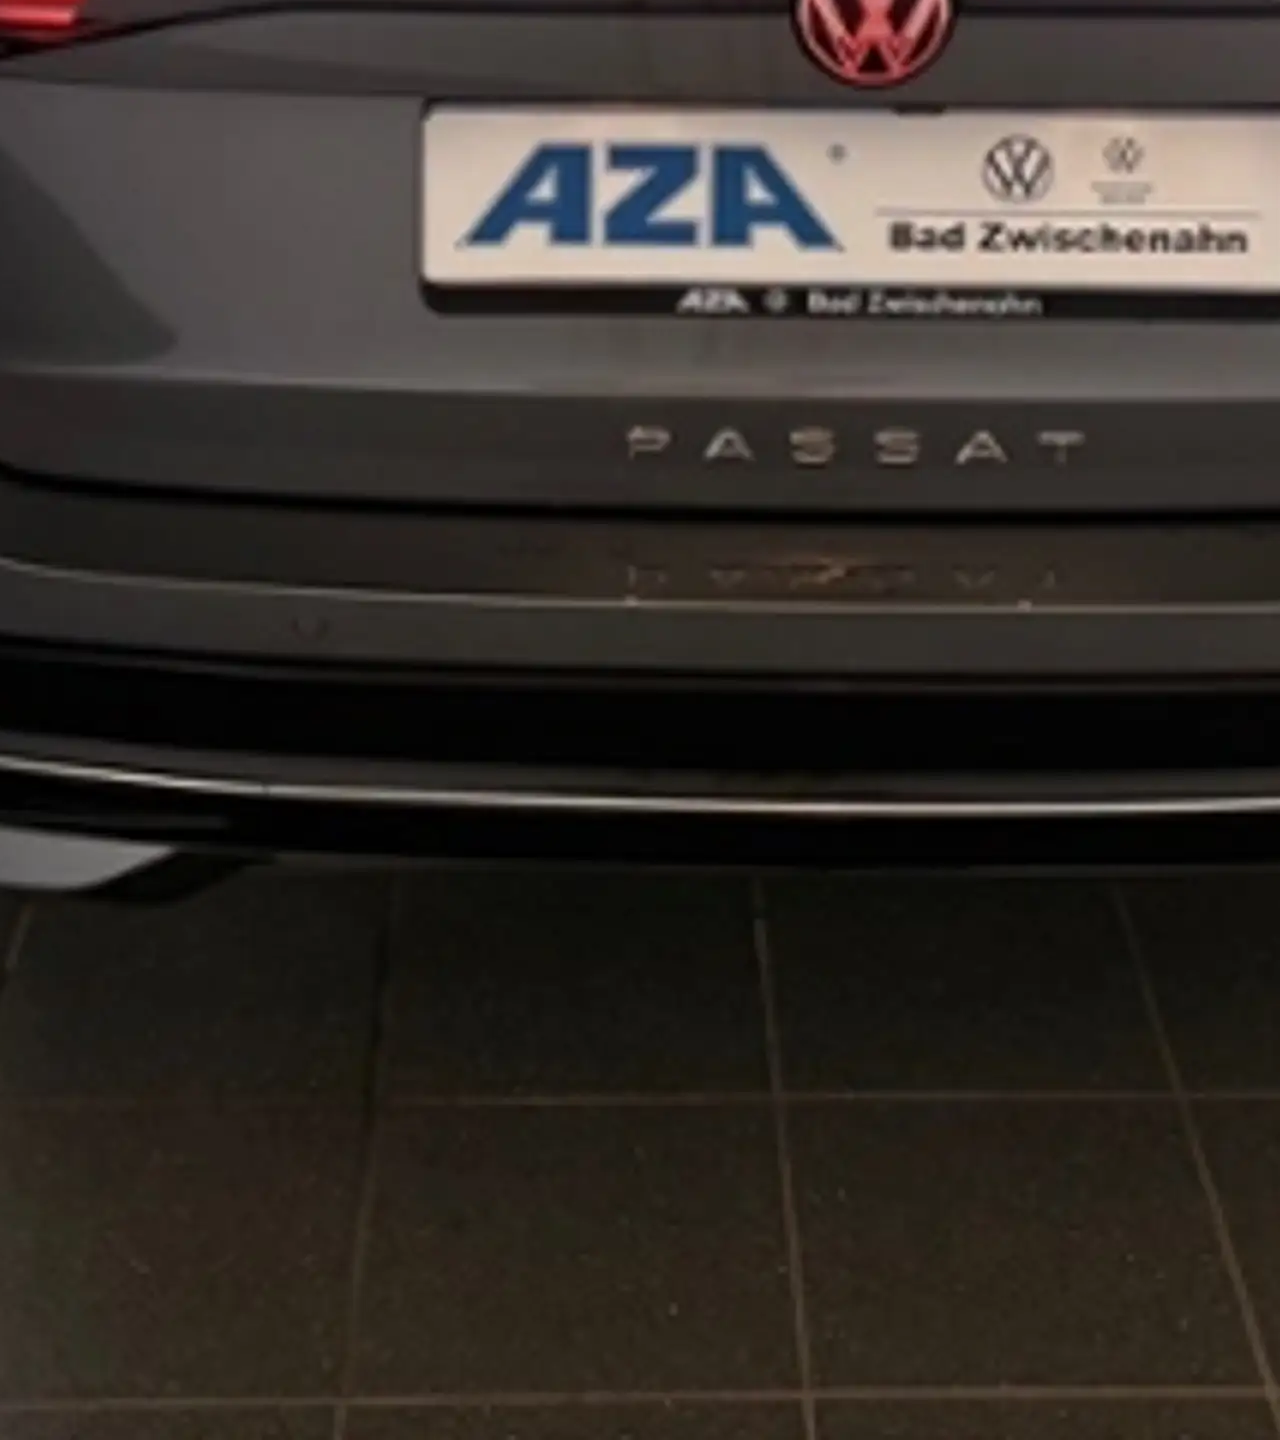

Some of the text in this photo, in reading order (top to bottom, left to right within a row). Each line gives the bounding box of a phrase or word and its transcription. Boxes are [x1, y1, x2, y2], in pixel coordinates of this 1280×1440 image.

[458, 140, 845, 252] AZA
[888, 221, 1248, 253] Bad Zwischenahn
[626, 425, 1087, 465] PASSAT
